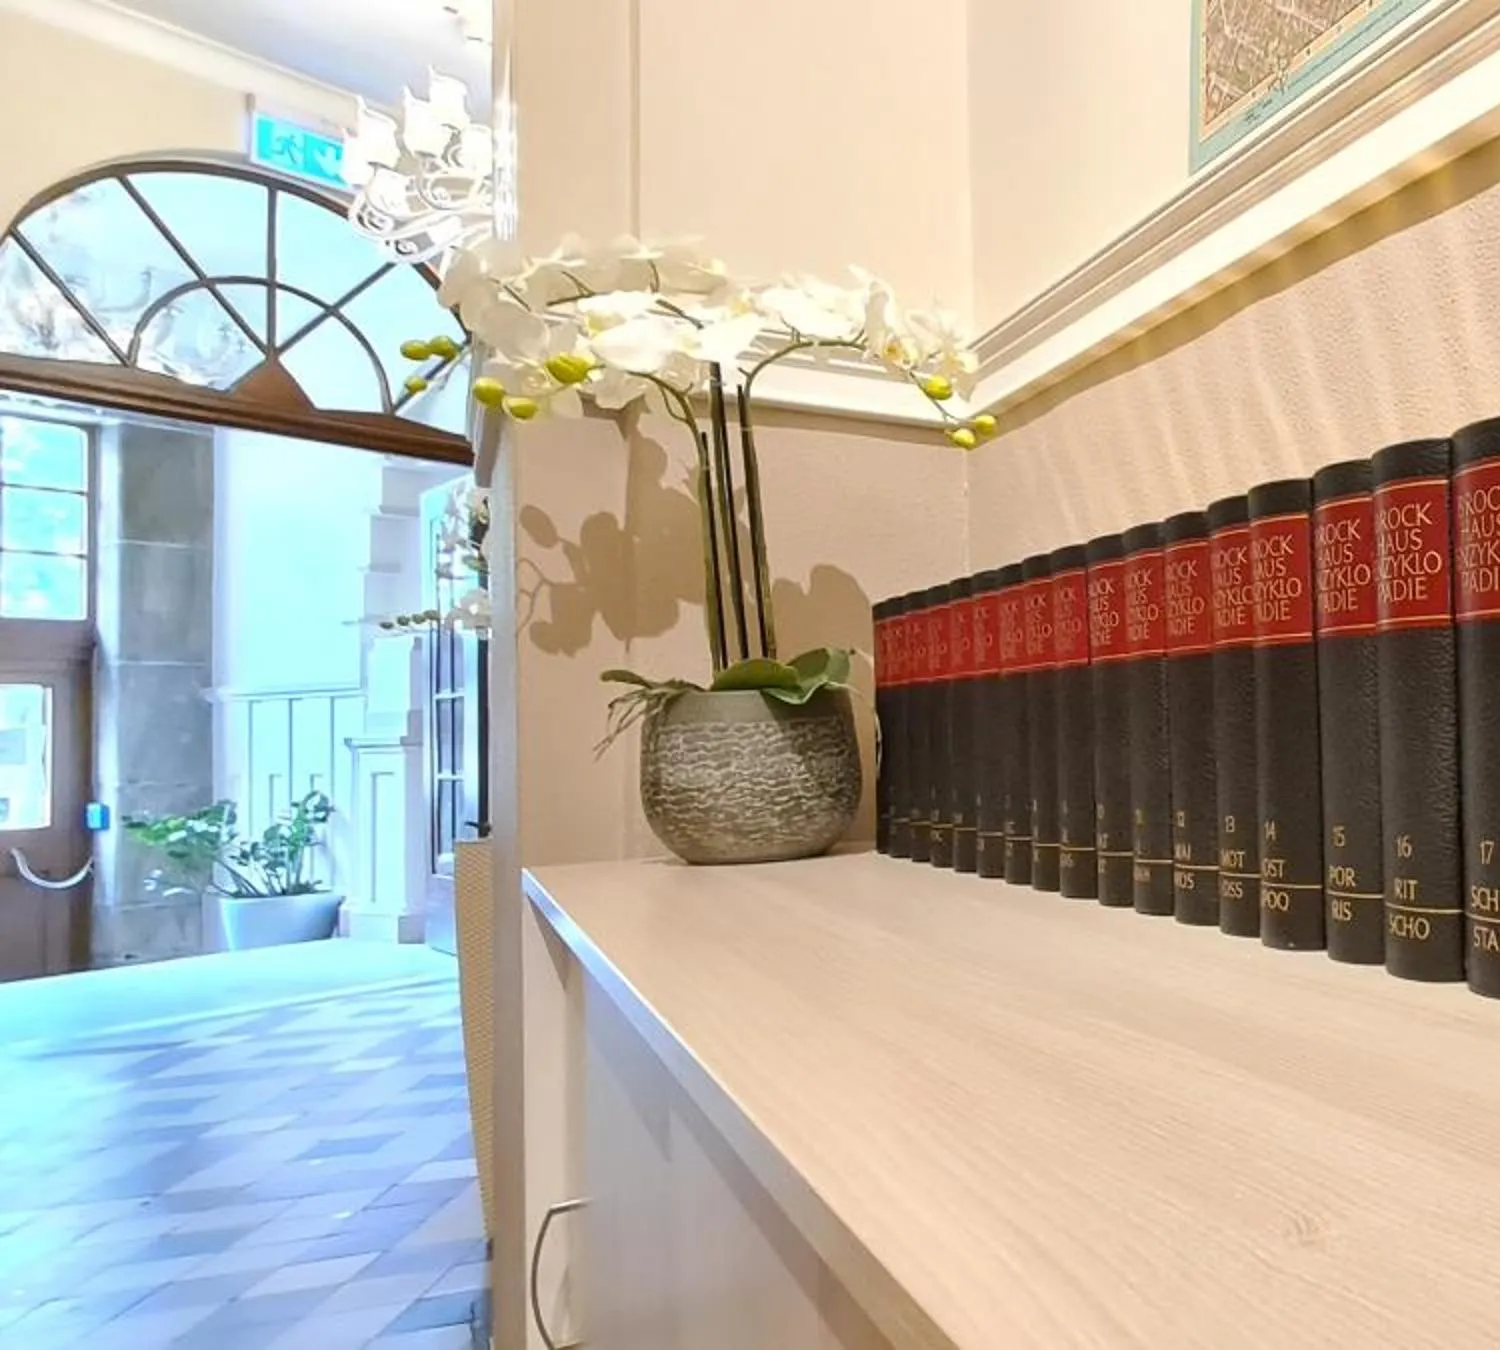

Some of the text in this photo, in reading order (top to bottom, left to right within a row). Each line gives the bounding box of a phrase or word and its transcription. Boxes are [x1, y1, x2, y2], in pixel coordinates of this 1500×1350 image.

[1377, 501, 1432, 530] ROCK
[1316, 518, 1361, 546] ROCK
[1252, 533, 1294, 559] OCK
[1318, 543, 1353, 567] AUS
[1254, 557, 1287, 580] AUS
[1319, 563, 1371, 592] ZYKLO
[1378, 550, 1442, 580] ZYKLO
[1254, 577, 1302, 602] YKLO
[1254, 600, 1292, 622] DIE
[1397, 835, 1412, 858] 16
[1480, 840, 1494, 865] 17
